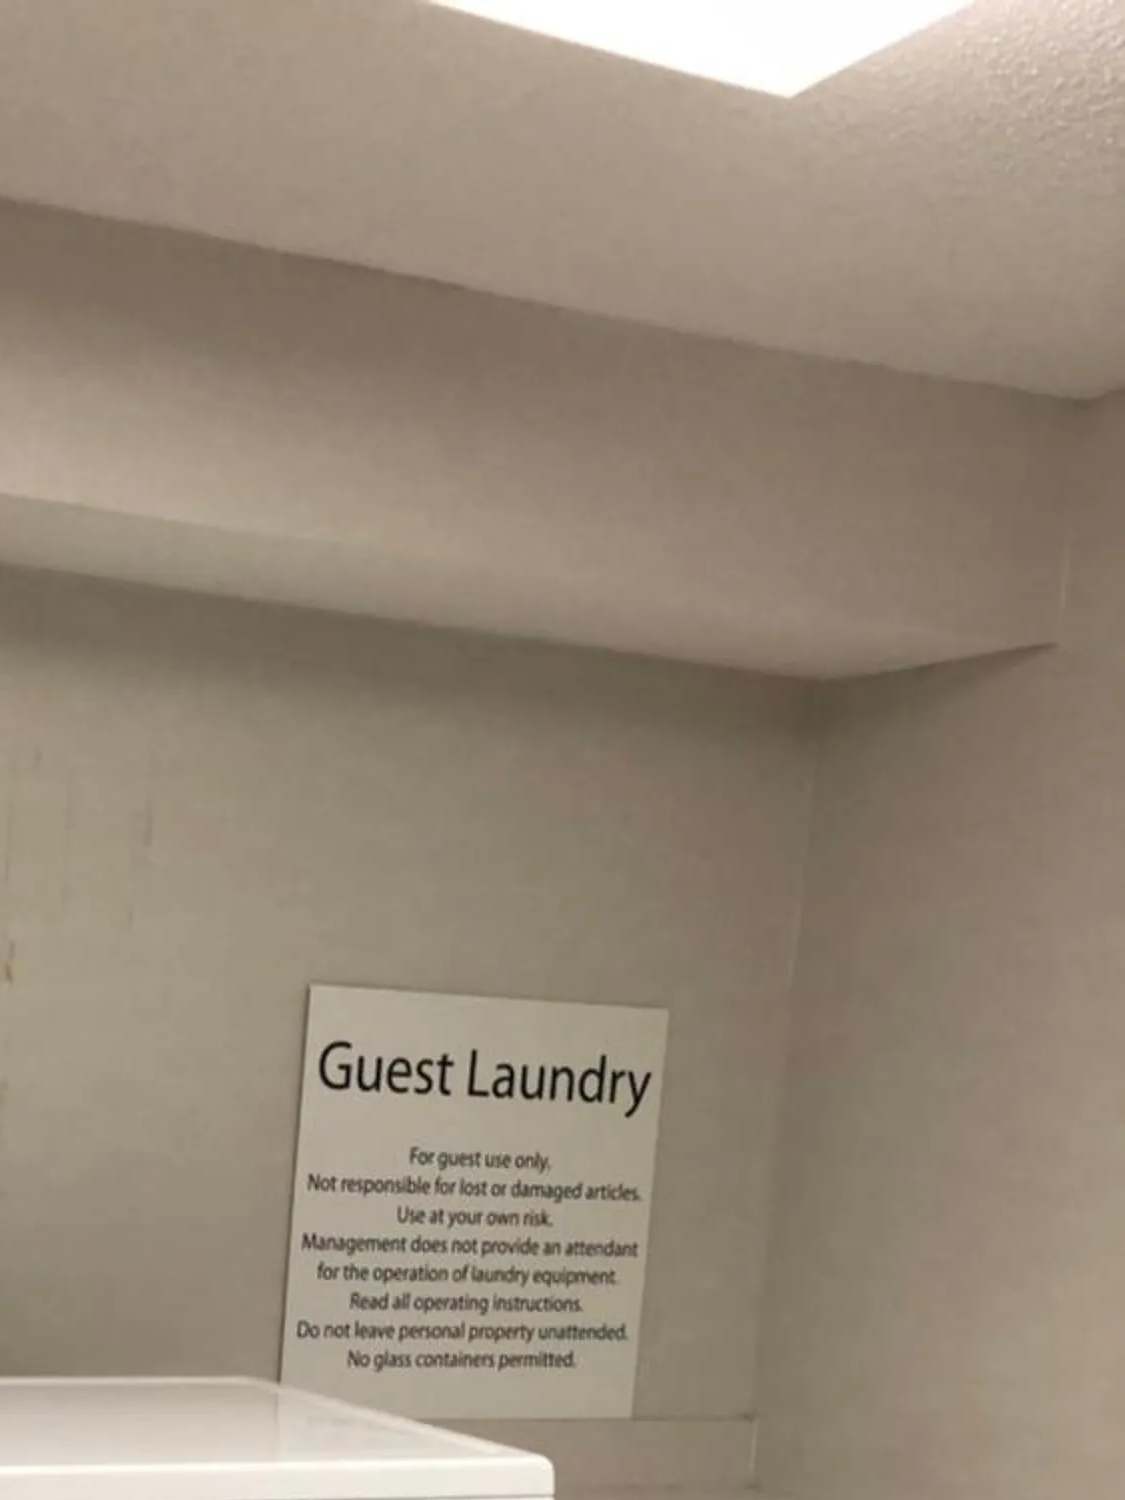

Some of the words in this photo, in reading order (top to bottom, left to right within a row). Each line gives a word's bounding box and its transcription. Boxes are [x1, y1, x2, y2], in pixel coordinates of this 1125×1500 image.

[318, 1040, 455, 1097] Guest
[467, 1049, 653, 1119] Laundry
[409, 1146, 435, 1166] For
[437, 1150, 481, 1171] guest
[484, 1153, 511, 1169] use
[515, 1151, 552, 1174] only.
[307, 1173, 337, 1192] Not
[340, 1176, 431, 1197] responsible
[434, 1176, 456, 1195] for
[459, 1178, 488, 1196] lost
[491, 1183, 507, 1197] or
[511, 1179, 583, 1203] damaged
[585, 1183, 641, 1201] articles.
[396, 1205, 426, 1224] Use
[429, 1208, 444, 1224] at
[447, 1211, 483, 1229] your
[486, 1212, 520, 1226] own
[523, 1209, 554, 1227] risk.
[301, 1232, 407, 1256] Management
[410, 1235, 448, 1253] does
[451, 1238, 478, 1254] not
[481, 1237, 540, 1258] provide
[542, 1241, 562, 1256] an
[564, 1240, 639, 1258] attendant
[316, 1261, 340, 1280] for
[343, 1264, 370, 1281] the
[373, 1264, 449, 1284] operation
[451, 1265, 469, 1283] of
[471, 1266, 529, 1288] laundry
[349, 1292, 389, 1311] Read
[392, 1293, 411, 1311] all
[413, 1294, 489, 1316] operating
[492, 1295, 584, 1313] instructions.
[296, 1320, 321, 1339] Do
[323, 1323, 351, 1339] not
[354, 1321, 396, 1340] leave
[398, 1322, 465, 1343] personal
[468, 1325, 535, 1344] property
[537, 1324, 629, 1342] unattended.
[347, 1350, 372, 1368] No
[374, 1351, 412, 1373] glass
[415, 1352, 495, 1369] containers
[497, 1352, 577, 1372] permitted.
